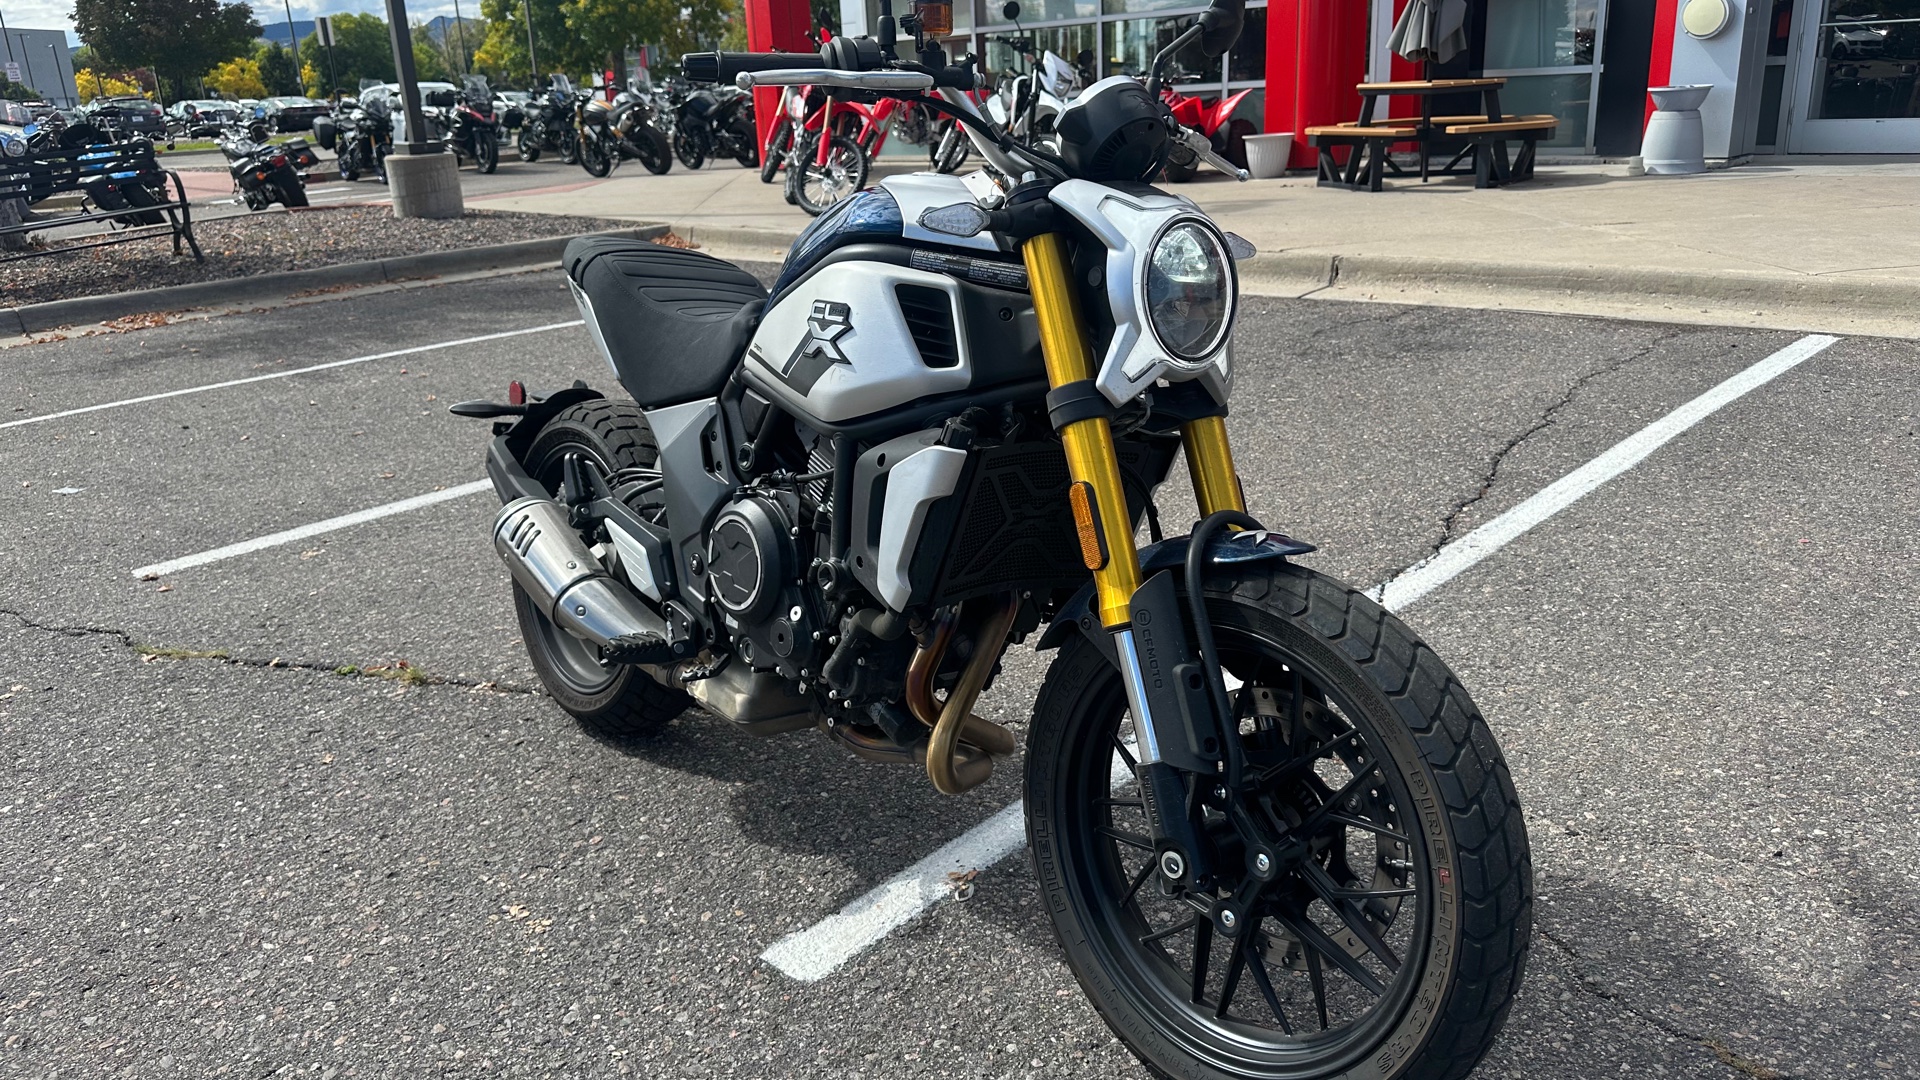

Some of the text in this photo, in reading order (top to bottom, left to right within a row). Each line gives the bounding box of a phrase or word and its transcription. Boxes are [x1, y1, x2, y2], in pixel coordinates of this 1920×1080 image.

[1142, 629, 1163, 689] CFMOTO
[1035, 781, 1067, 914] PIRELLI
[1410, 769, 1454, 930] PIRELLI
